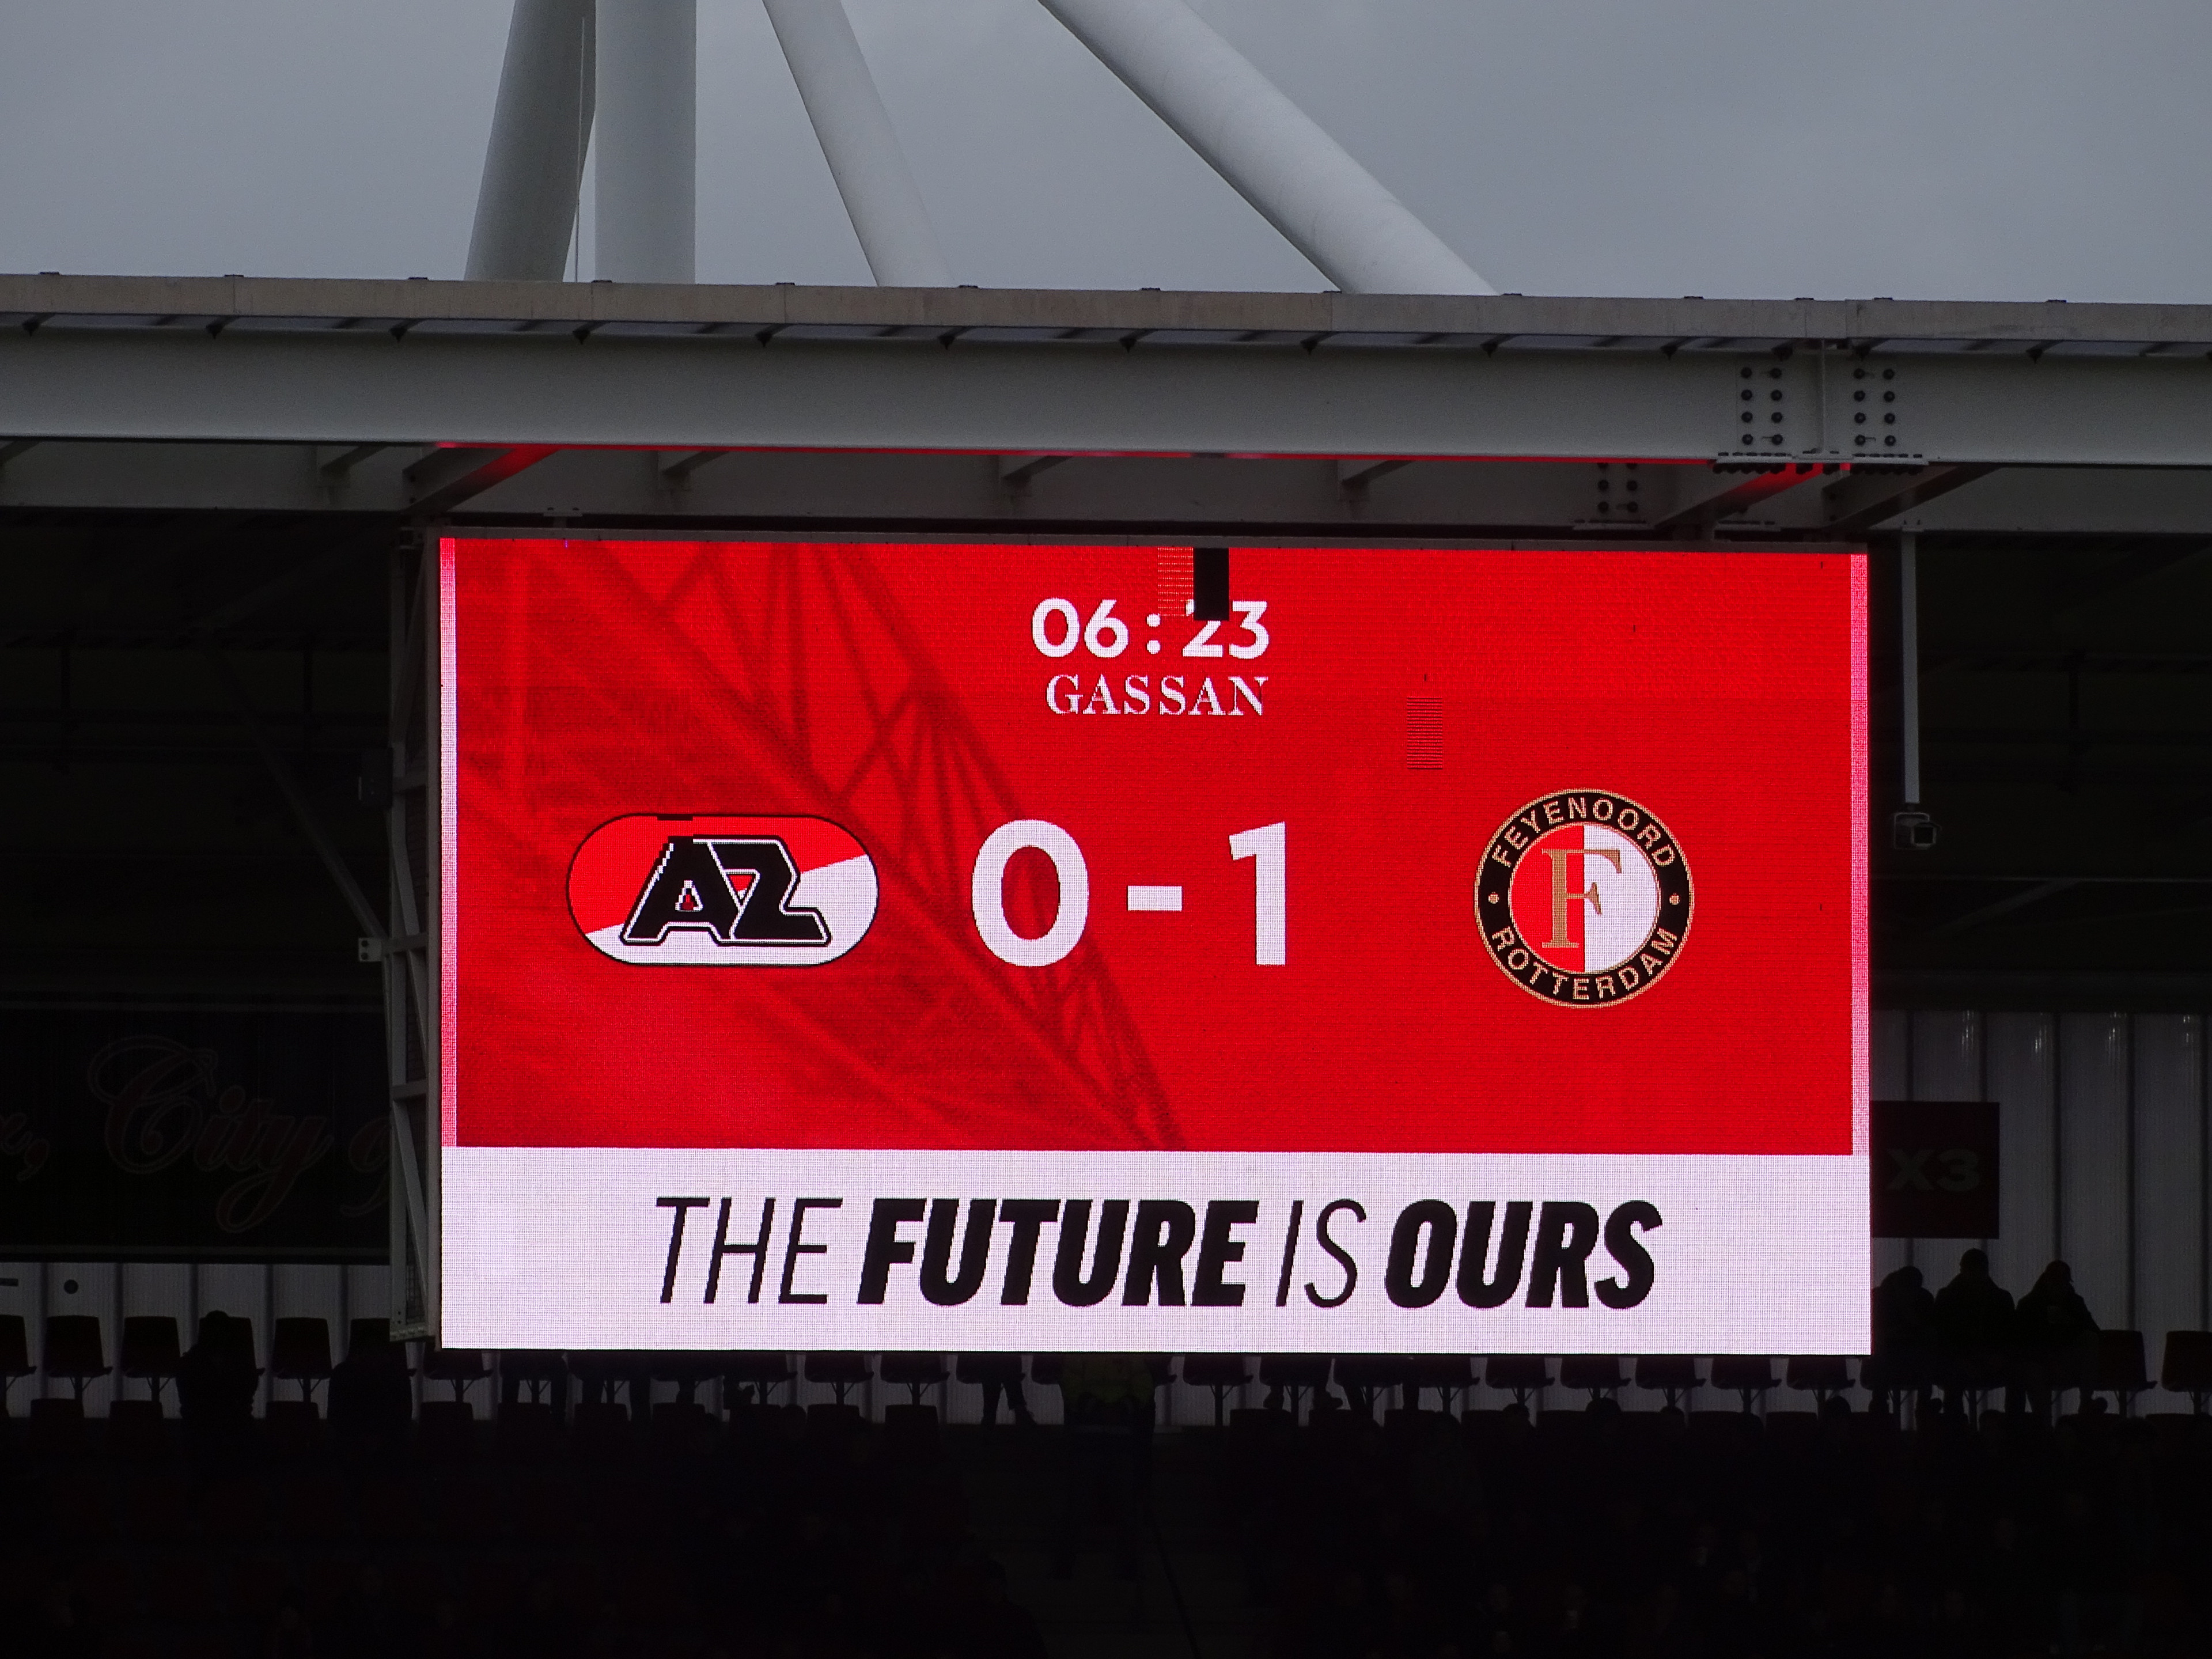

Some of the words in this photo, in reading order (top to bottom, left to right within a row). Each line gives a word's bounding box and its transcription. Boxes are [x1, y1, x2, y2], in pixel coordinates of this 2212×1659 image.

[1046, 673, 1268, 715] GASSAN
[1492, 797, 1675, 868] FEYENOORD
[620, 835, 831, 947] AZ
[972, 819, 1089, 967] 0
[1229, 821, 1286, 965] 1
[1541, 848, 1622, 948] F
[1492, 926, 1677, 1000] ROTTERDAM
[87, 1036, 335, 1233] City
[1886, 1148, 1981, 1192] X3
[656, 1196, 843, 1305] THE
[856, 1198, 1260, 1307] FUTURE
[1275, 1198, 1368, 1309] IS
[1384, 1198, 1664, 1309] OURS
